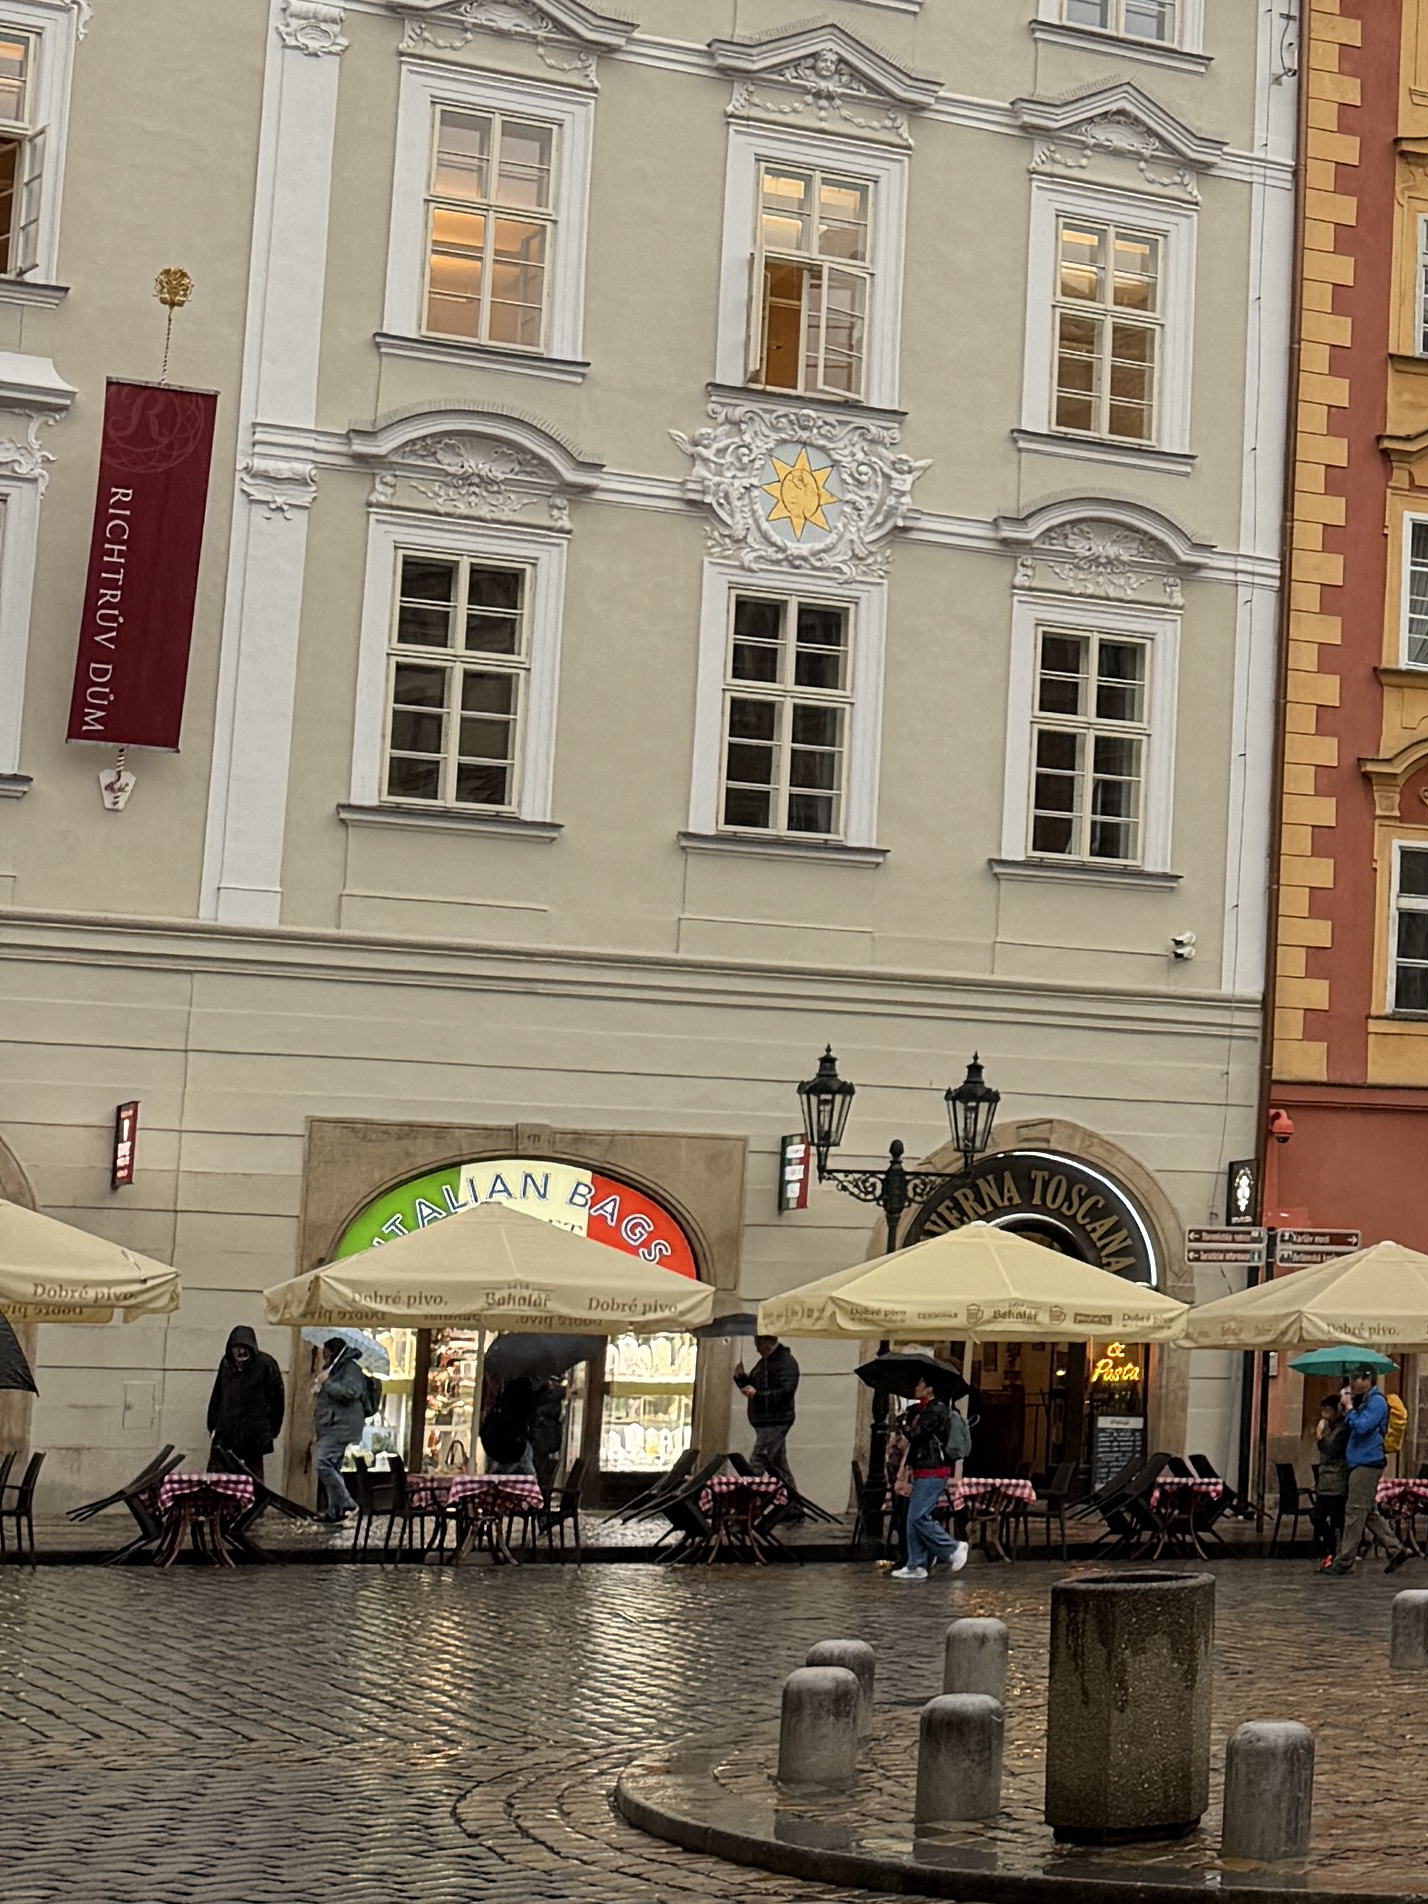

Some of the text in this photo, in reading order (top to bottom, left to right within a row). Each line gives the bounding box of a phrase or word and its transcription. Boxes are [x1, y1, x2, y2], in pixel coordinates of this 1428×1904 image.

[81, 487, 133, 733] RICHTRŮV DŮM
[372, 1170, 672, 1264] TALIAN BAGS
[919, 1169, 1138, 1274] VERNA TOSCANA
[33, 1283, 89, 1298] Dobré
[406, 1292, 448, 1308] pivo.
[588, 1296, 638, 1313] Dobré
[1368, 1322, 1400, 1338] pivo.
[1091, 1362, 1140, 1383] Pasta
